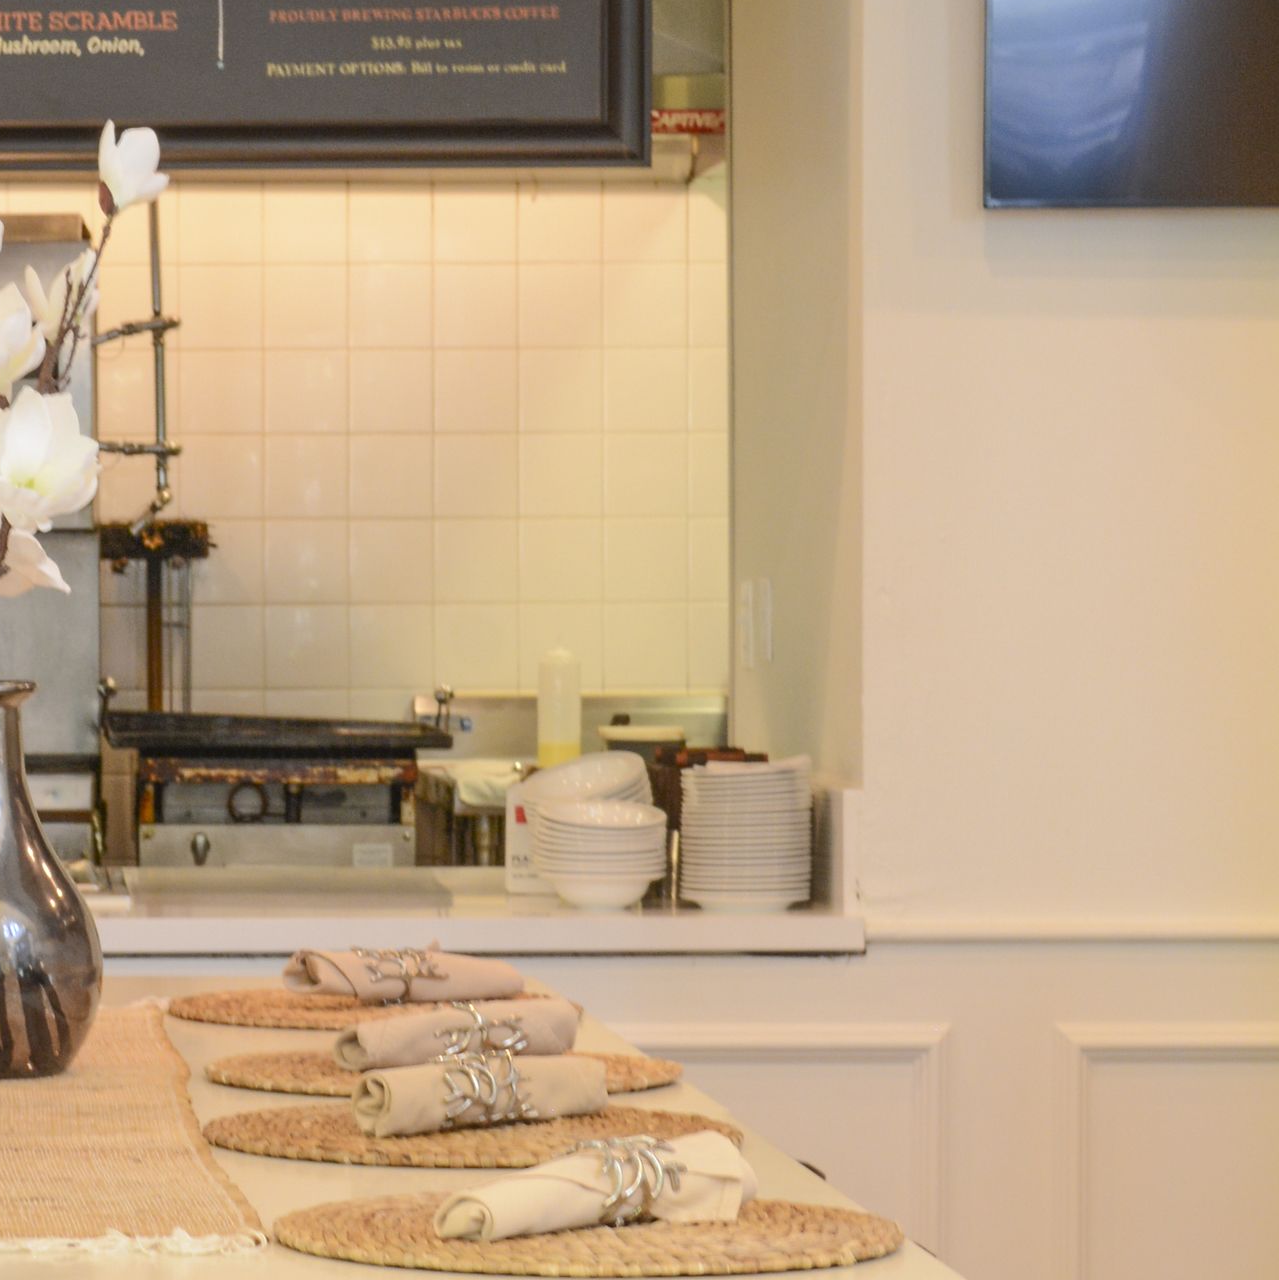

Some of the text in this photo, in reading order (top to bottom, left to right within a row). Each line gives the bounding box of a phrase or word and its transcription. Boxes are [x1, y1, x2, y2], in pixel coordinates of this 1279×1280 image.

[49, 10, 178, 32] SCRAMBLE
[87, 35, 145, 57] Onion,
[266, 62, 336, 77] PAYMENT
